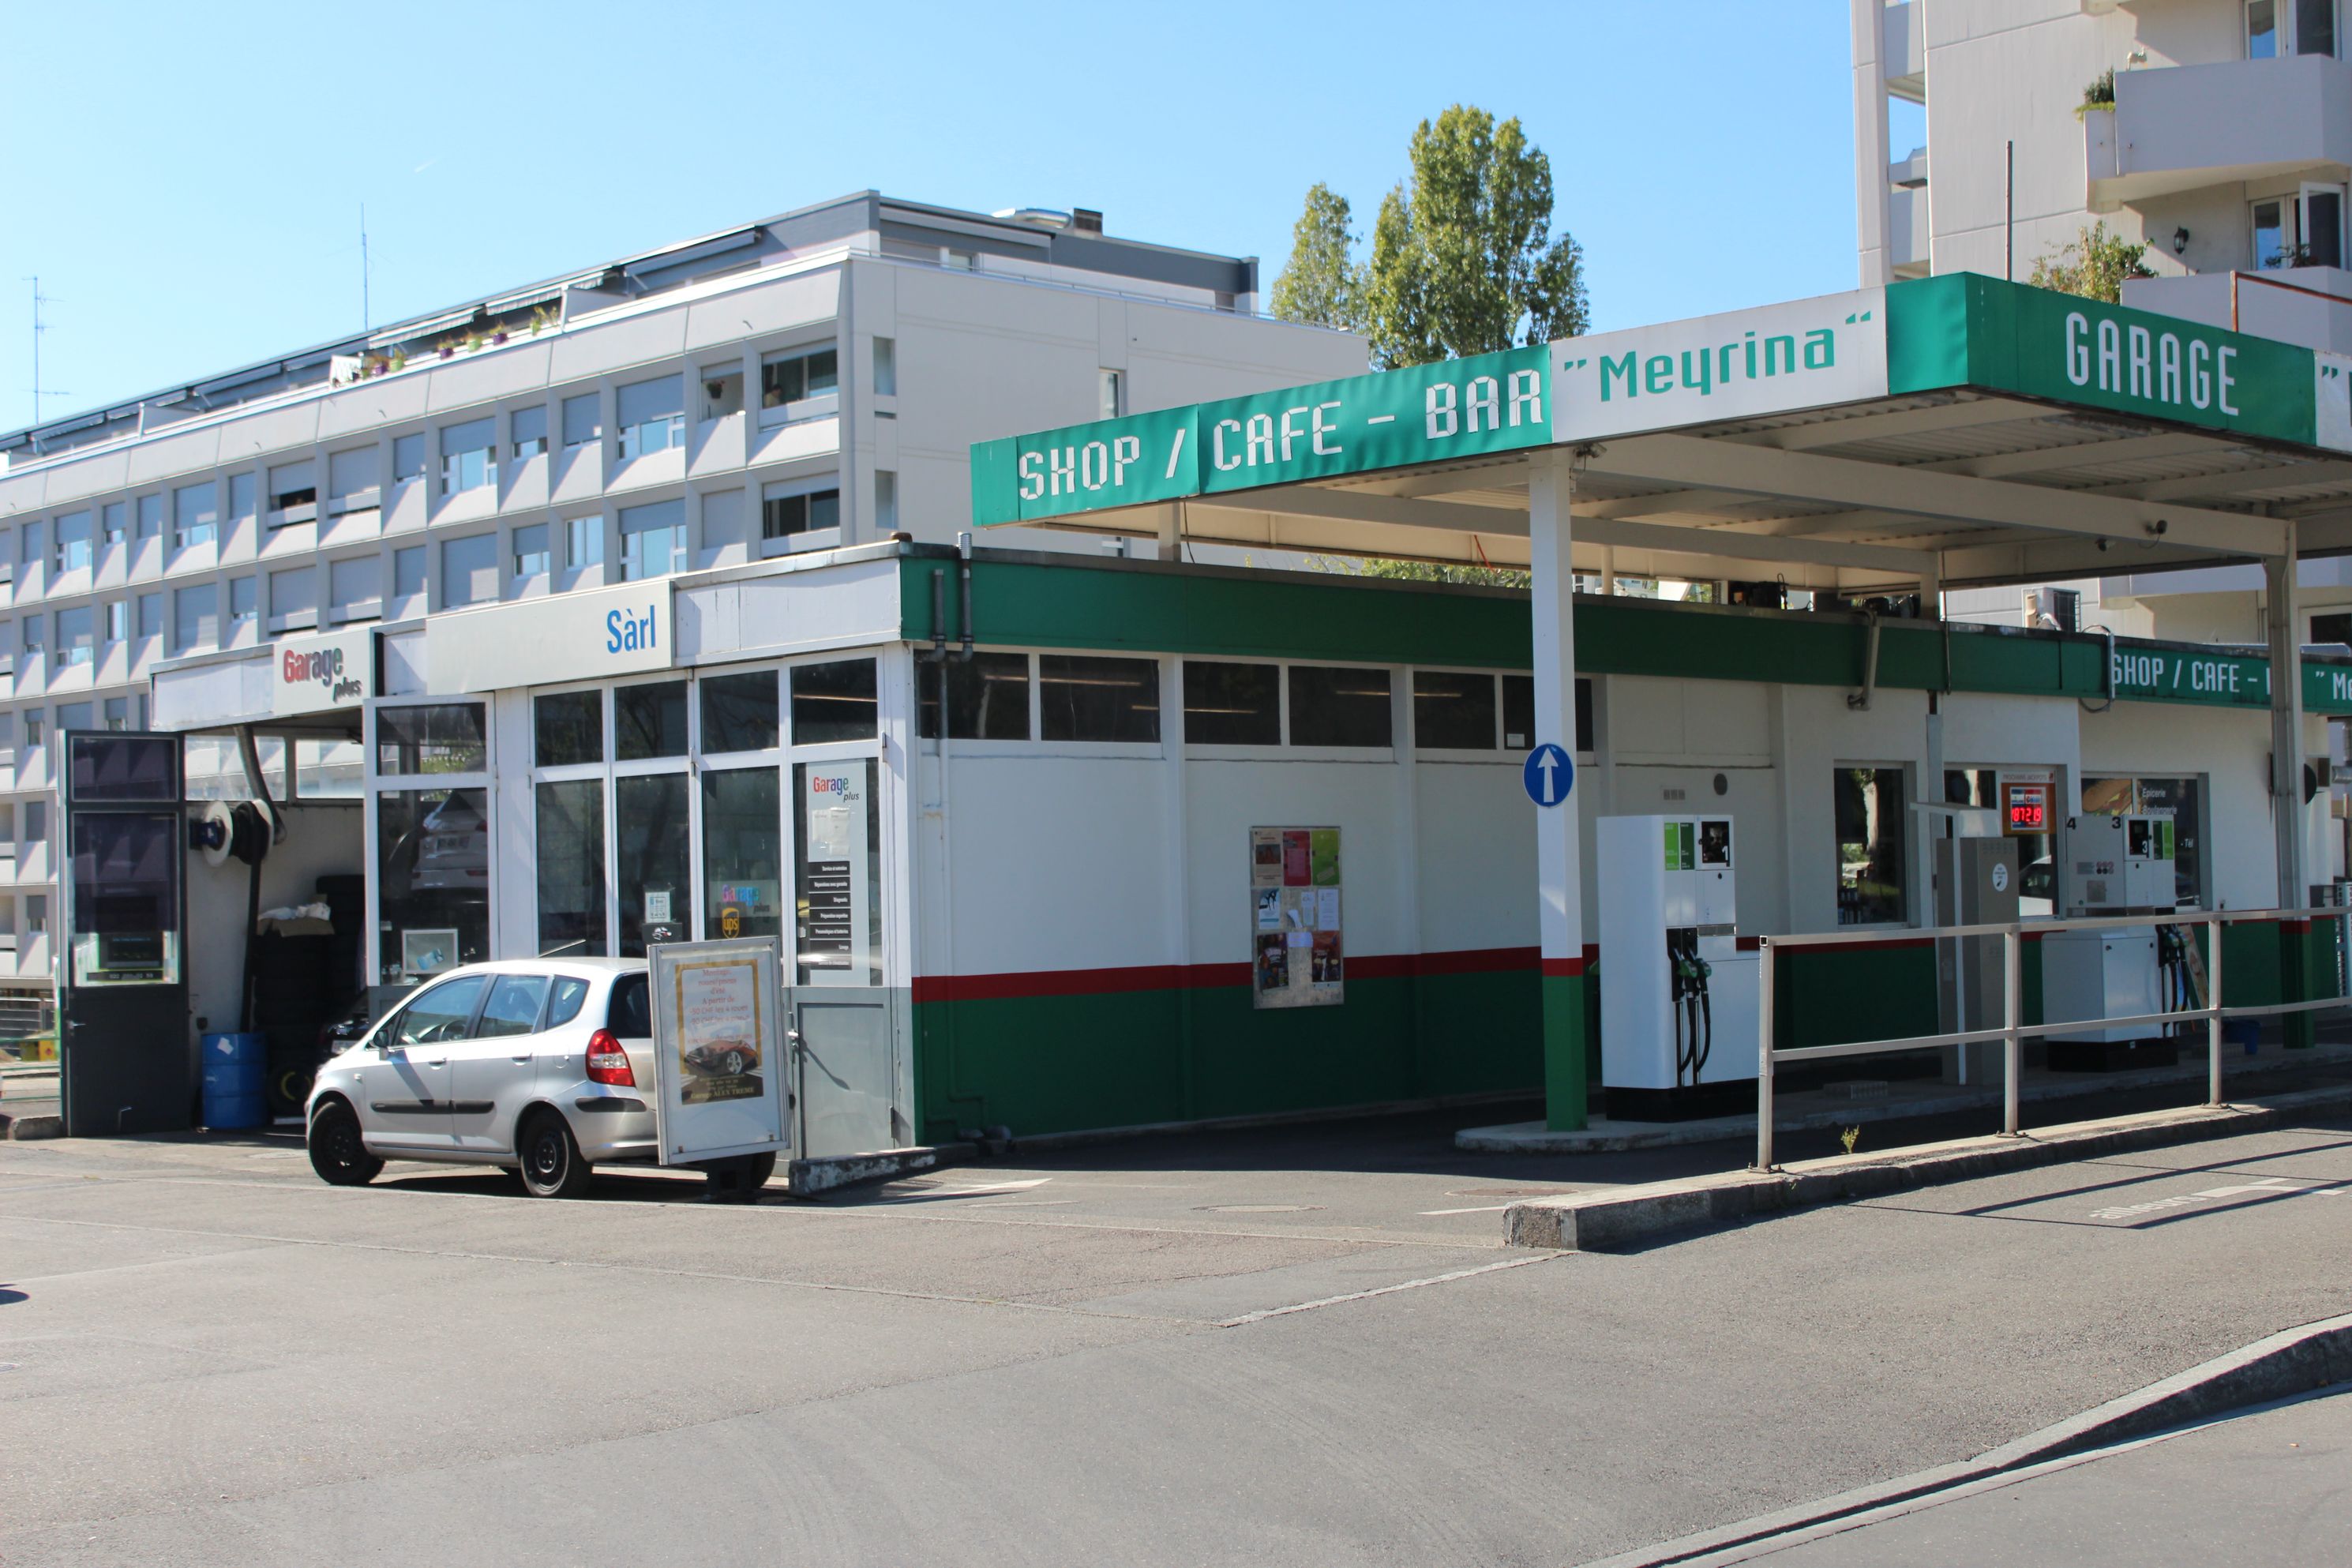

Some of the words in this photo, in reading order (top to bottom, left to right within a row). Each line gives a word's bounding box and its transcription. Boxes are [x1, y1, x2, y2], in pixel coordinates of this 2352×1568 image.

[2065, 311, 2239, 417] GARAGE
[1019, 436, 1140, 500] SHOP
[1165, 428, 1187, 479] /
[1214, 401, 1343, 471] CAFE
[1367, 415, 1395, 426] -
[1426, 369, 1544, 440] BAR
[606, 604, 656, 655] Sàrl
[284, 647, 343, 688] Garage
[2113, 654, 2164, 688] SHOP
[2173, 659, 2183, 689] /
[2192, 661, 2241, 693] CAFE
[332, 677, 362, 703] plus
[812, 777, 850, 796] Garage
[842, 791, 860, 803] plus
[2066, 816, 2076, 830] 4
[2112, 816, 2121, 829] 3
[1721, 846, 1729, 861] 1
[2141, 840, 2148, 853] 3
[722, 883, 760, 907] Garage
